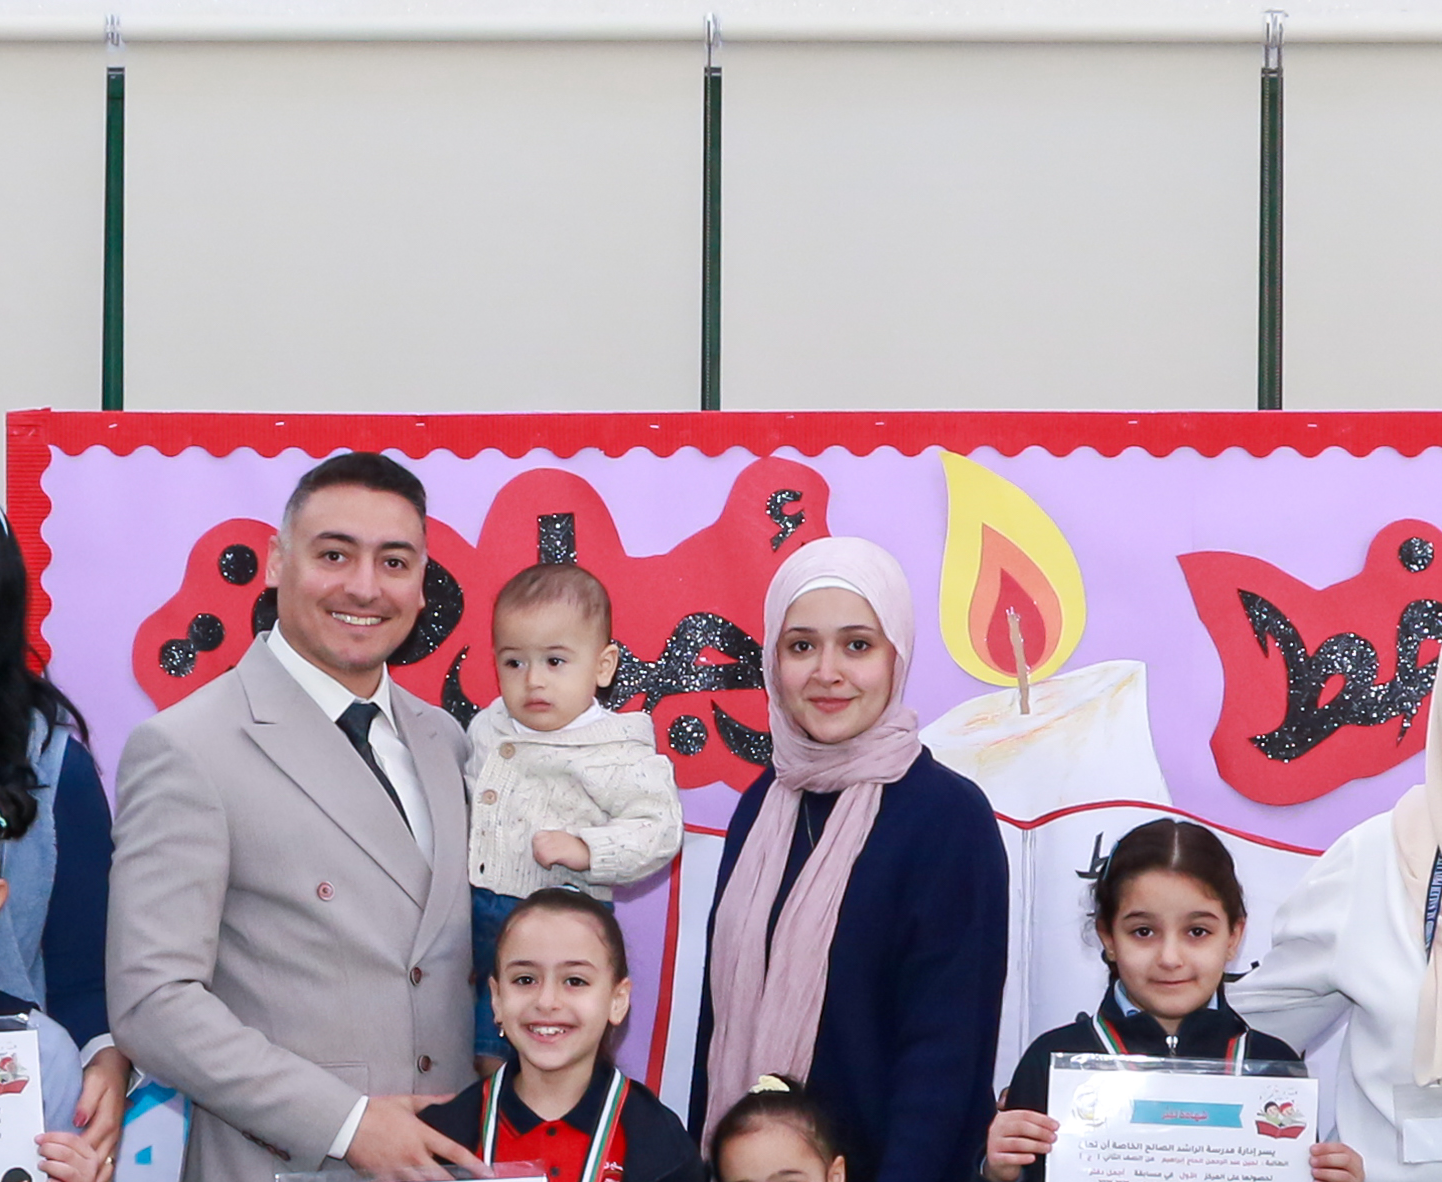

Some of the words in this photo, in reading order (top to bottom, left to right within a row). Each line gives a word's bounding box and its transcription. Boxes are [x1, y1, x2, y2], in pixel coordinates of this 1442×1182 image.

[1099, 1140, 1110, 1150] أن
[1111, 1140, 1142, 1150] الخاصة
[1144, 1143, 1174, 1154] الصالح
[1176, 1143, 1204, 1154] الراشد
[1205, 1144, 1235, 1155] مدرسة
[1237, 1145, 1256, 1157] إدارة
[1257, 1149, 1275, 1157] يسر
[1144, 1155, 1155, 1163] من
[1133, 1168, 1161, 1177] مسابقة
[1163, 1171, 1173, 1180] في
[1226, 1173, 1239, 1182] على
